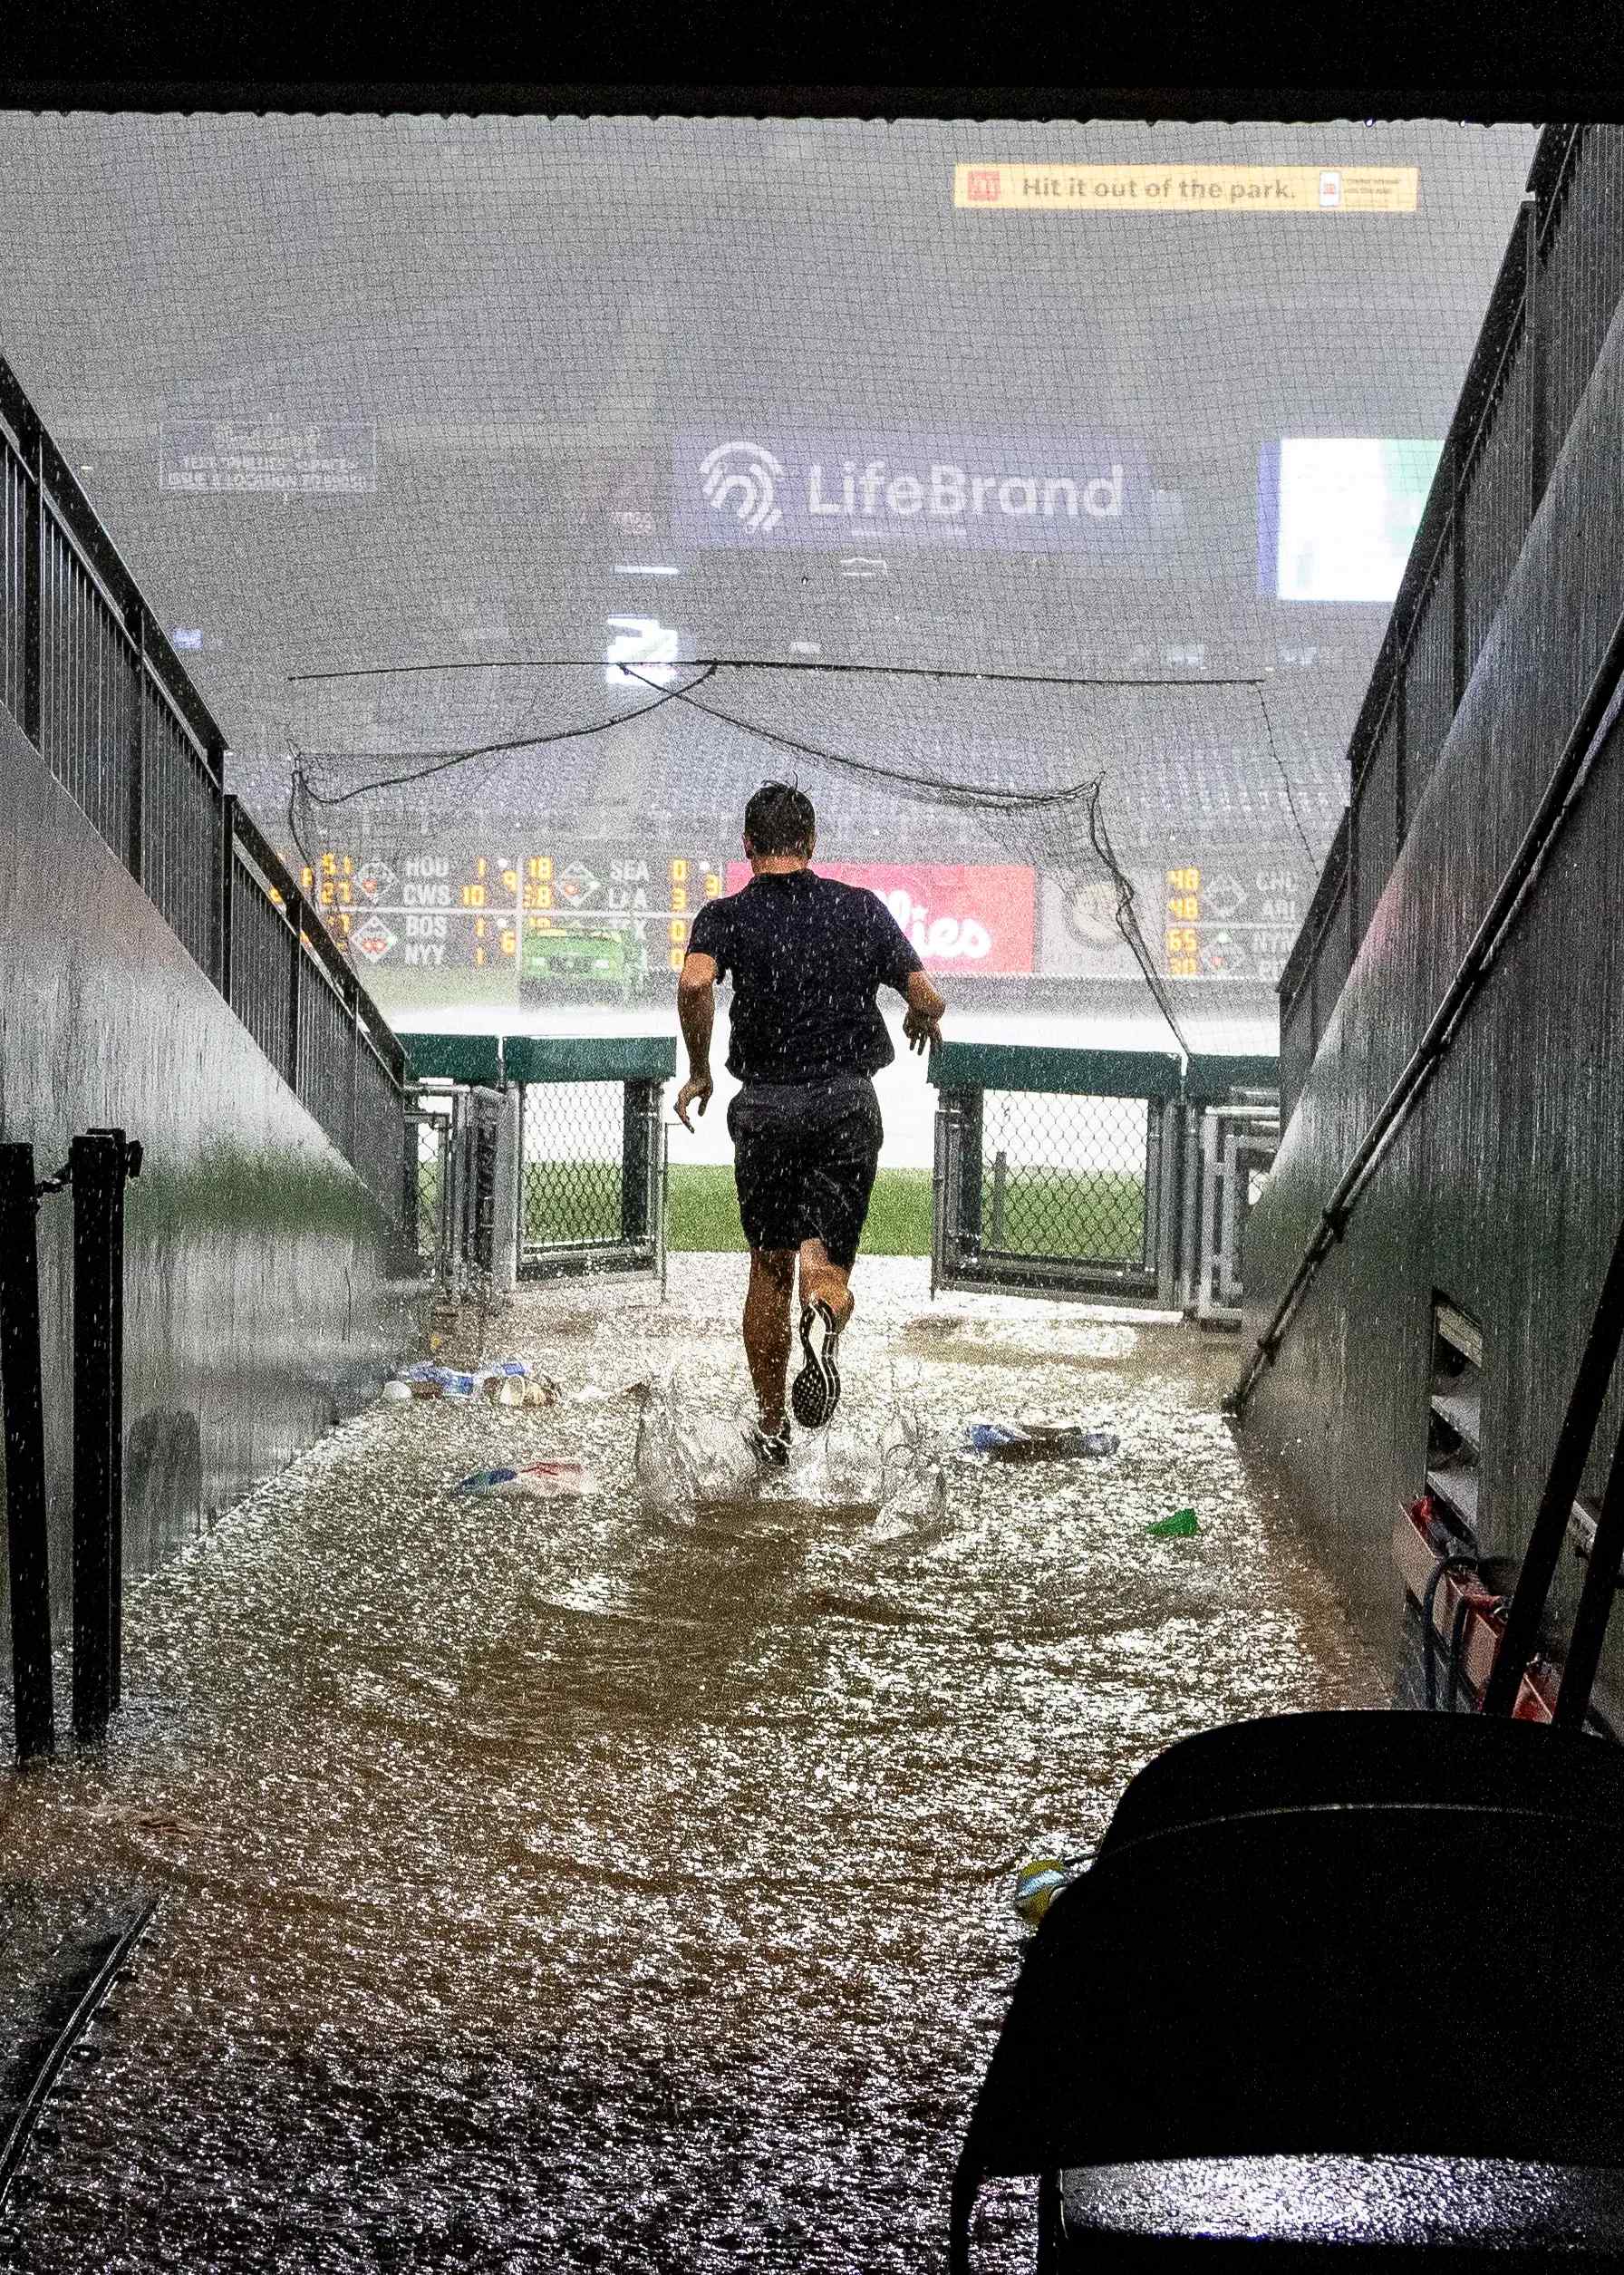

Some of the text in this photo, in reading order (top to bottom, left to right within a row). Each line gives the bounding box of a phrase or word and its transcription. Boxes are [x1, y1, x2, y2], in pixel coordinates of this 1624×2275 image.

[1022, 178, 1297, 203] Hit it out of the park.
[808, 461, 1123, 517] LifeBrand
[405, 857, 450, 876] HOU
[527, 857, 552, 880] 18
[610, 859, 649, 881] SEA
[403, 885, 450, 905] CWS
[461, 886, 486, 906] 10
[405, 916, 447, 936] BOS
[501, 931, 516, 955] 6
[404, 944, 446, 965] NYY
